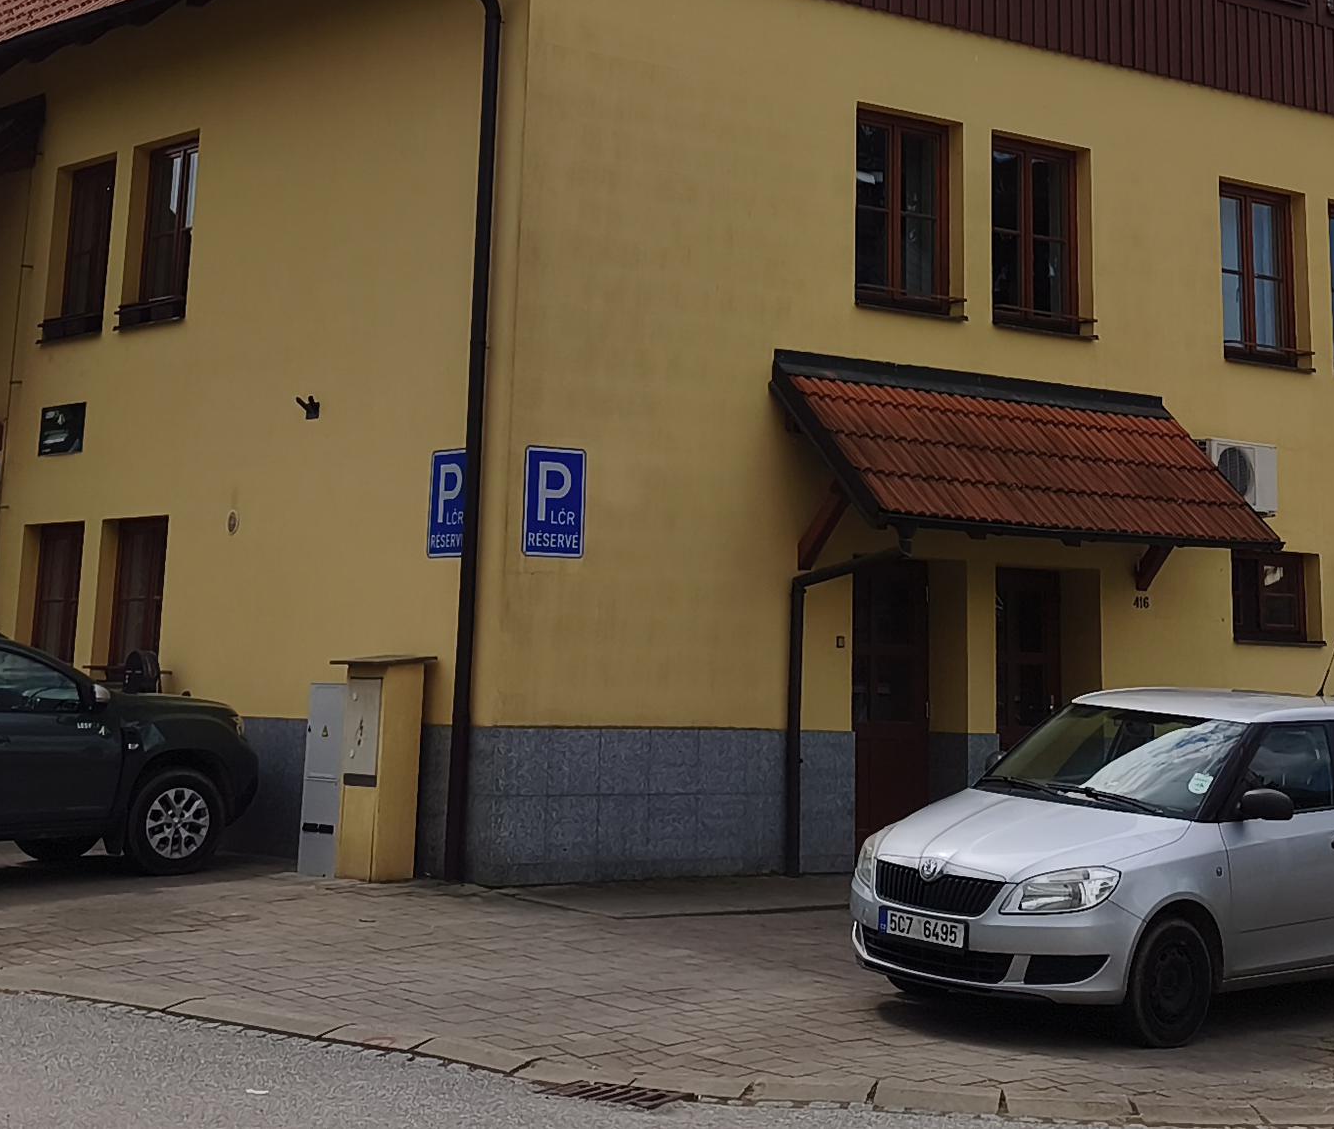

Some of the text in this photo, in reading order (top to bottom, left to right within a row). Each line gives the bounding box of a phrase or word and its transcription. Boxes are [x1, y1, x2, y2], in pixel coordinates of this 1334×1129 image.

[437, 463, 463, 523] P
[537, 461, 572, 521] P
[550, 507, 575, 525] LČR
[430, 531, 463, 549] RÉSERV
[527, 530, 579, 549] RÉSERVÉ
[1133, 596, 1149, 609] 416
[890, 913, 913, 934] 5C7
[923, 920, 958, 943] 6495
